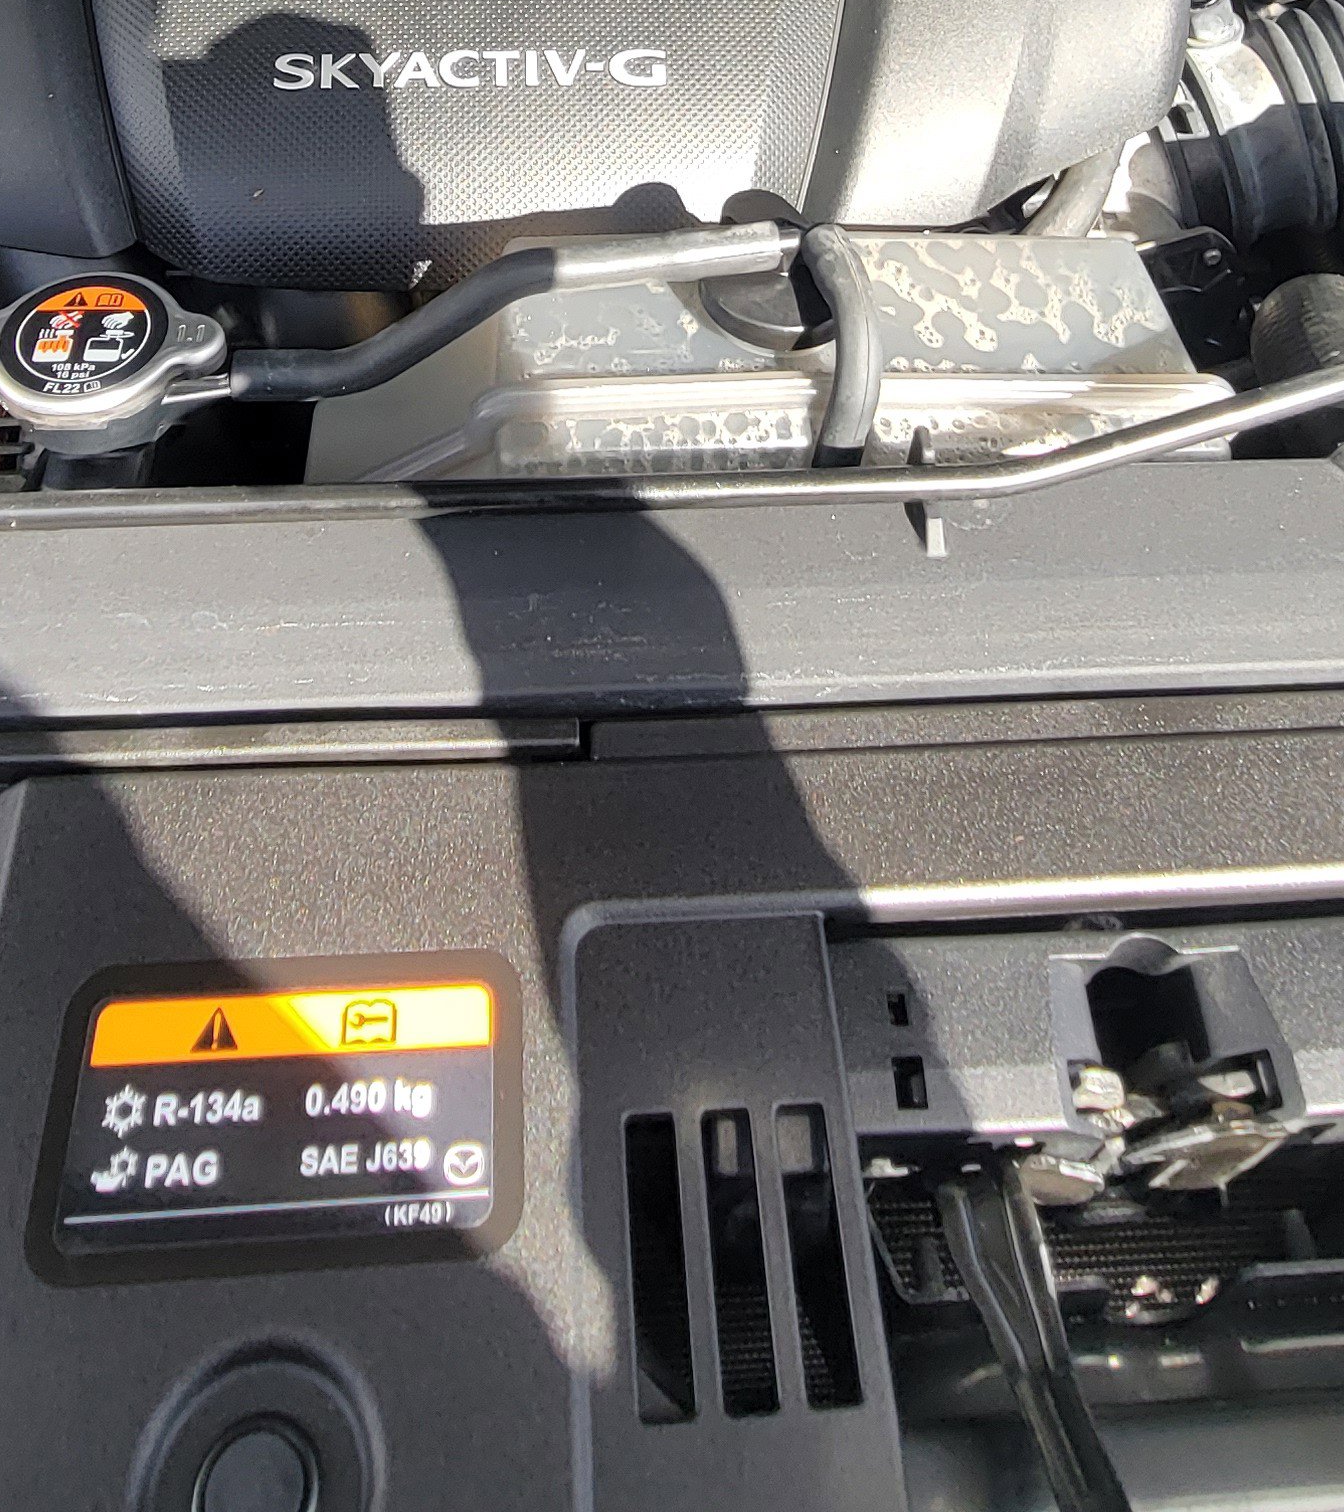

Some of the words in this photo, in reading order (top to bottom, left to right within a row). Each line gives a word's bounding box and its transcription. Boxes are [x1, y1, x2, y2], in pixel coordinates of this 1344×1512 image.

[272, 48, 668, 90] SKYACTIV-G
[177, 324, 205, 343] 1.1
[70, 371, 90, 380] psi
[73, 362, 96, 371] kPa
[42, 381, 81, 394] FL22
[153, 1088, 263, 1127] R-134a
[306, 1079, 387, 1118] 0.490
[393, 1078, 433, 1119] kg
[144, 1149, 220, 1189] PAG
[299, 1142, 359, 1177] SAE
[366, 1137, 431, 1173] J639
[384, 1201, 452, 1227] (KF49)
